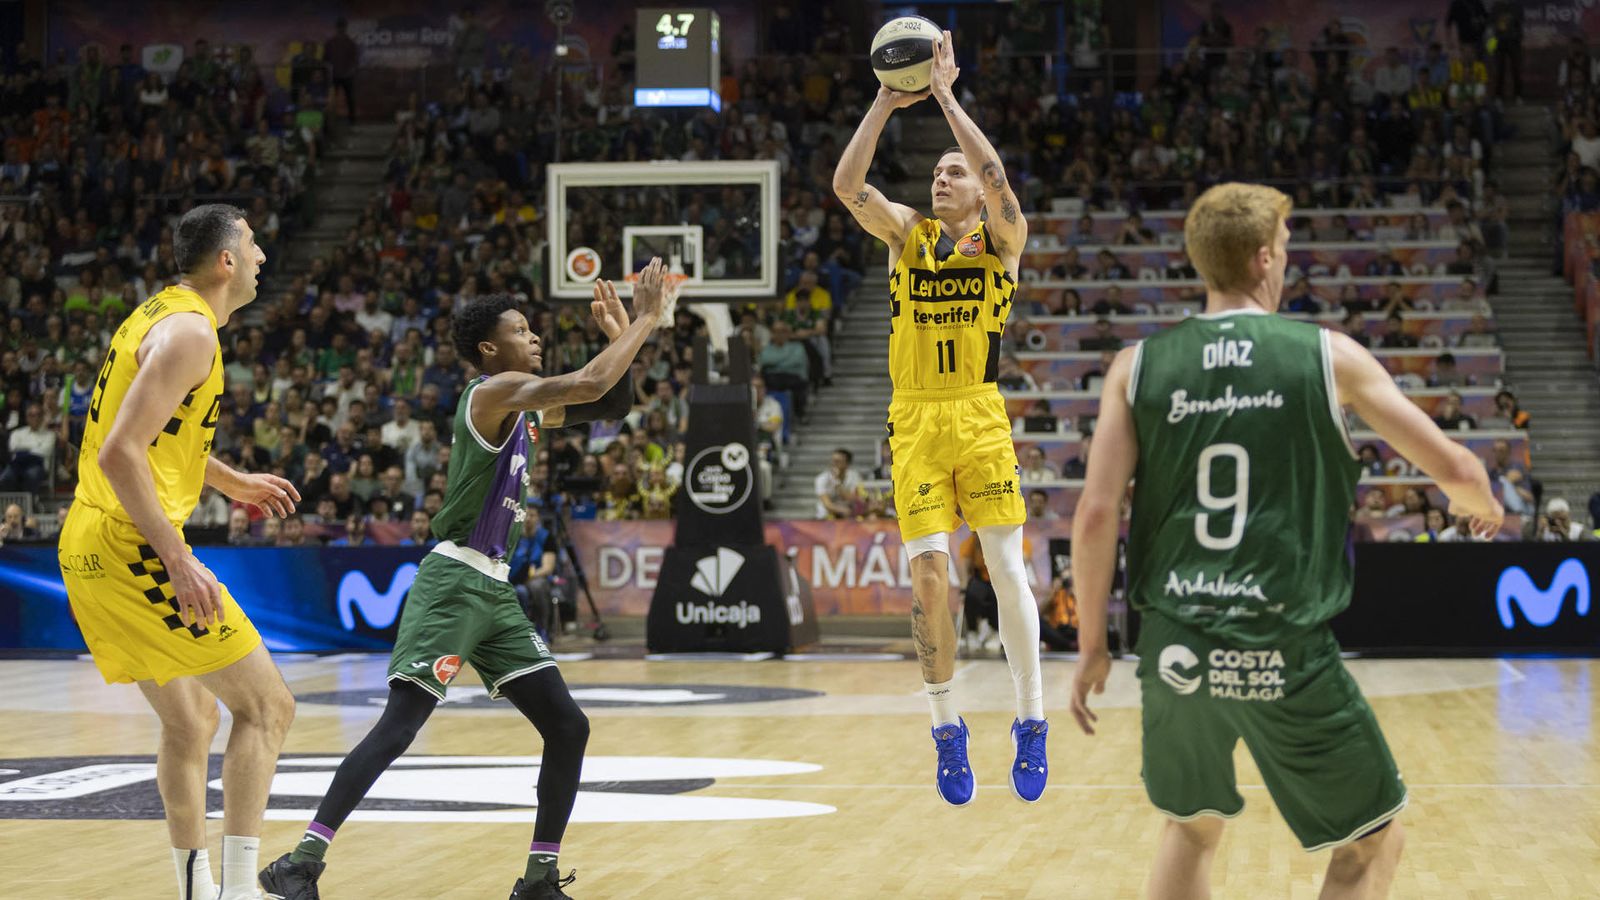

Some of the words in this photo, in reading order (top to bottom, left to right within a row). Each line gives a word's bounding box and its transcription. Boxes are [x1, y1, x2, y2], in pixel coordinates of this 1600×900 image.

[656, 13, 695, 36] 4.7
[904, 22, 922, 31] 2024
[911, 273, 983, 297] Lenovo
[936, 339, 956, 374] 11
[1203, 336, 1252, 370] DÍAZ
[1167, 385, 1283, 424] Benahavís
[1195, 443, 1249, 550] 9
[676, 600, 760, 628] Unicaja
[1208, 649, 1285, 669] COSTA
[1208, 669, 1245, 685] DEL
[1248, 670, 1286, 686] SOL
[1210, 685, 1285, 702] MÁLAGA
